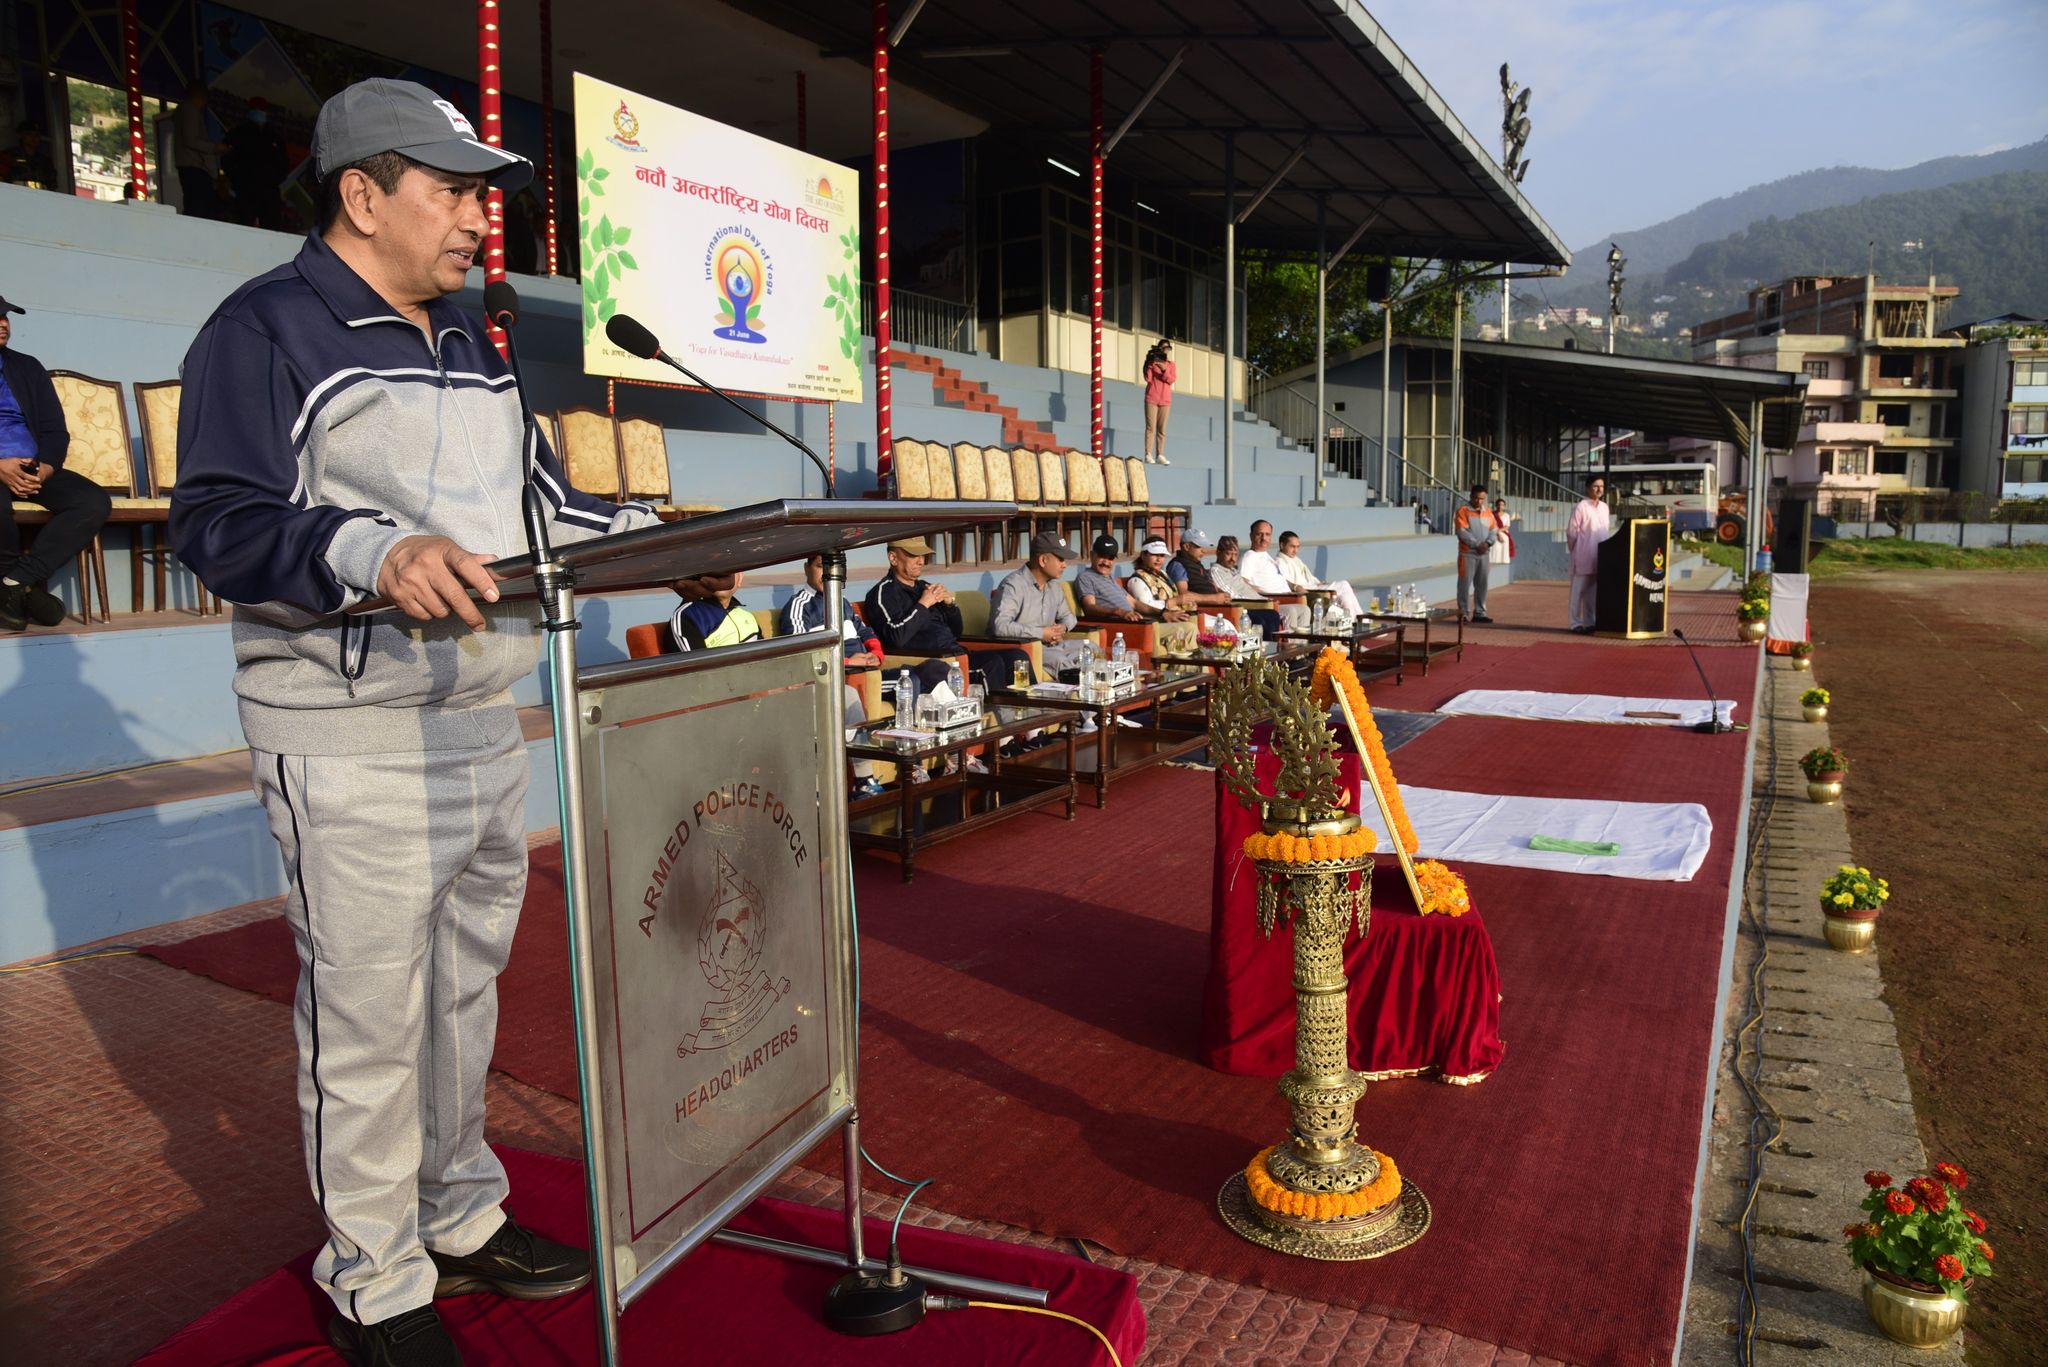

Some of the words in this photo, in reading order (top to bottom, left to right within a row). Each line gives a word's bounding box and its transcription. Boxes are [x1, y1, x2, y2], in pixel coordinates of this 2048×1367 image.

[763, 199, 791, 222] योग
[796, 207, 829, 233] दिवस
[704, 224, 743, 281] International
[744, 227, 761, 247] Day
[760, 248, 771, 260] of
[766, 263, 774, 295] Yoga
[736, 330, 750, 339] June
[638, 820, 690, 938] ARMED
[693, 782, 760, 827] POLICE
[763, 791, 807, 868] FORCE
[675, 1023, 798, 1123] HEADQUARTERS
